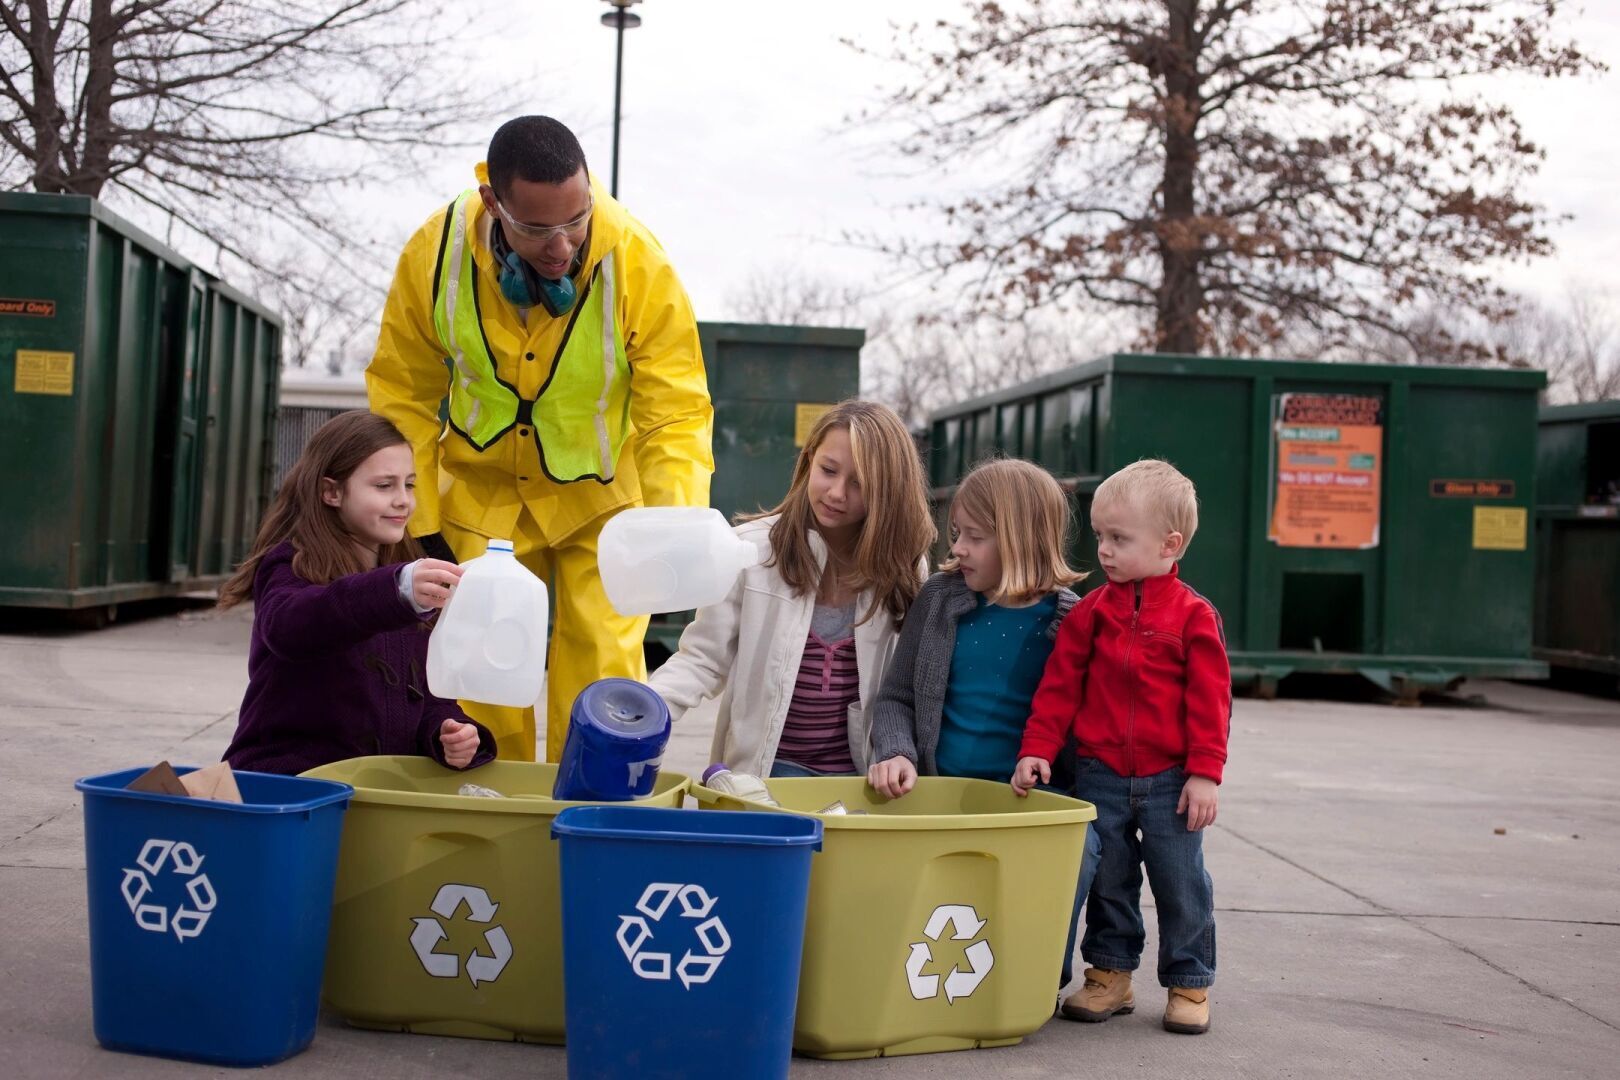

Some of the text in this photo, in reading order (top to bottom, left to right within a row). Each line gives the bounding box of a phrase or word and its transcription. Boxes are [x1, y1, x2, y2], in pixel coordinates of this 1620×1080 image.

[26, 303, 53, 315] Only
[1286, 396, 1380, 410] CORRUGATED
[1286, 408, 1376, 423] CARDBOARD
[1299, 428, 1339, 440] ACCEPT
[1280, 473, 1368, 486] We DO NOT Accept
[1477, 482, 1500, 496] Only
